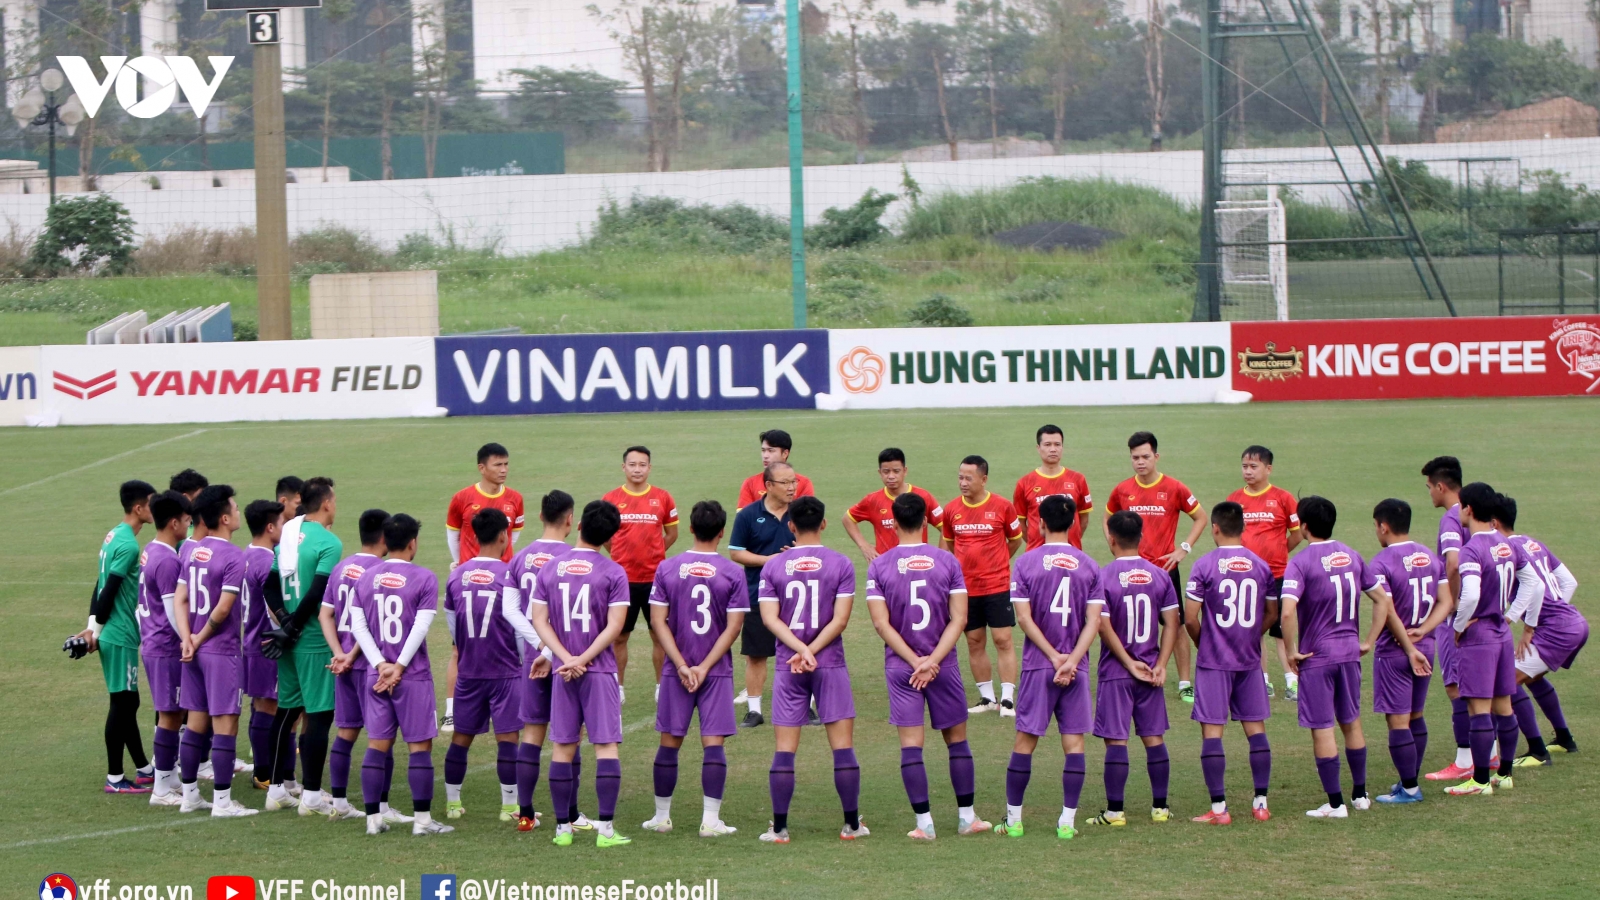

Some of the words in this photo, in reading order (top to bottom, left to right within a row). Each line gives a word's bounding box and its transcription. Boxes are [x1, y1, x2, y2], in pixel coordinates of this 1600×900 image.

[255, 14, 272, 41] 3
[130, 368, 321, 396] YANMAR
[331, 364, 422, 392] FIELD
[453, 342, 811, 403] VINAMILK
[890, 350, 996, 384] HUNG
[1001, 348, 1118, 382] THINH
[1125, 346, 1225, 380] LAND
[1249, 360, 1266, 368] KING
[1267, 360, 1293, 368] COFFEE
[1308, 343, 1399, 377] KING
[1405, 340, 1546, 375] COFFEE
[620, 513, 658, 521] HONDA
[954, 523, 993, 531] HONDA
[188, 566, 210, 615] 15
[559, 583, 591, 632] 14
[691, 584, 711, 634] 3
[786, 580, 818, 629] 21
[910, 580, 930, 630] 5
[1050, 577, 1071, 626] 4
[1216, 578, 1257, 627] 30
[1330, 572, 1356, 622] 11
[1409, 576, 1434, 625] 15
[1496, 561, 1514, 612] 10
[374, 594, 403, 644] 18
[462, 590, 497, 637] 17
[1123, 593, 1151, 643] 10
